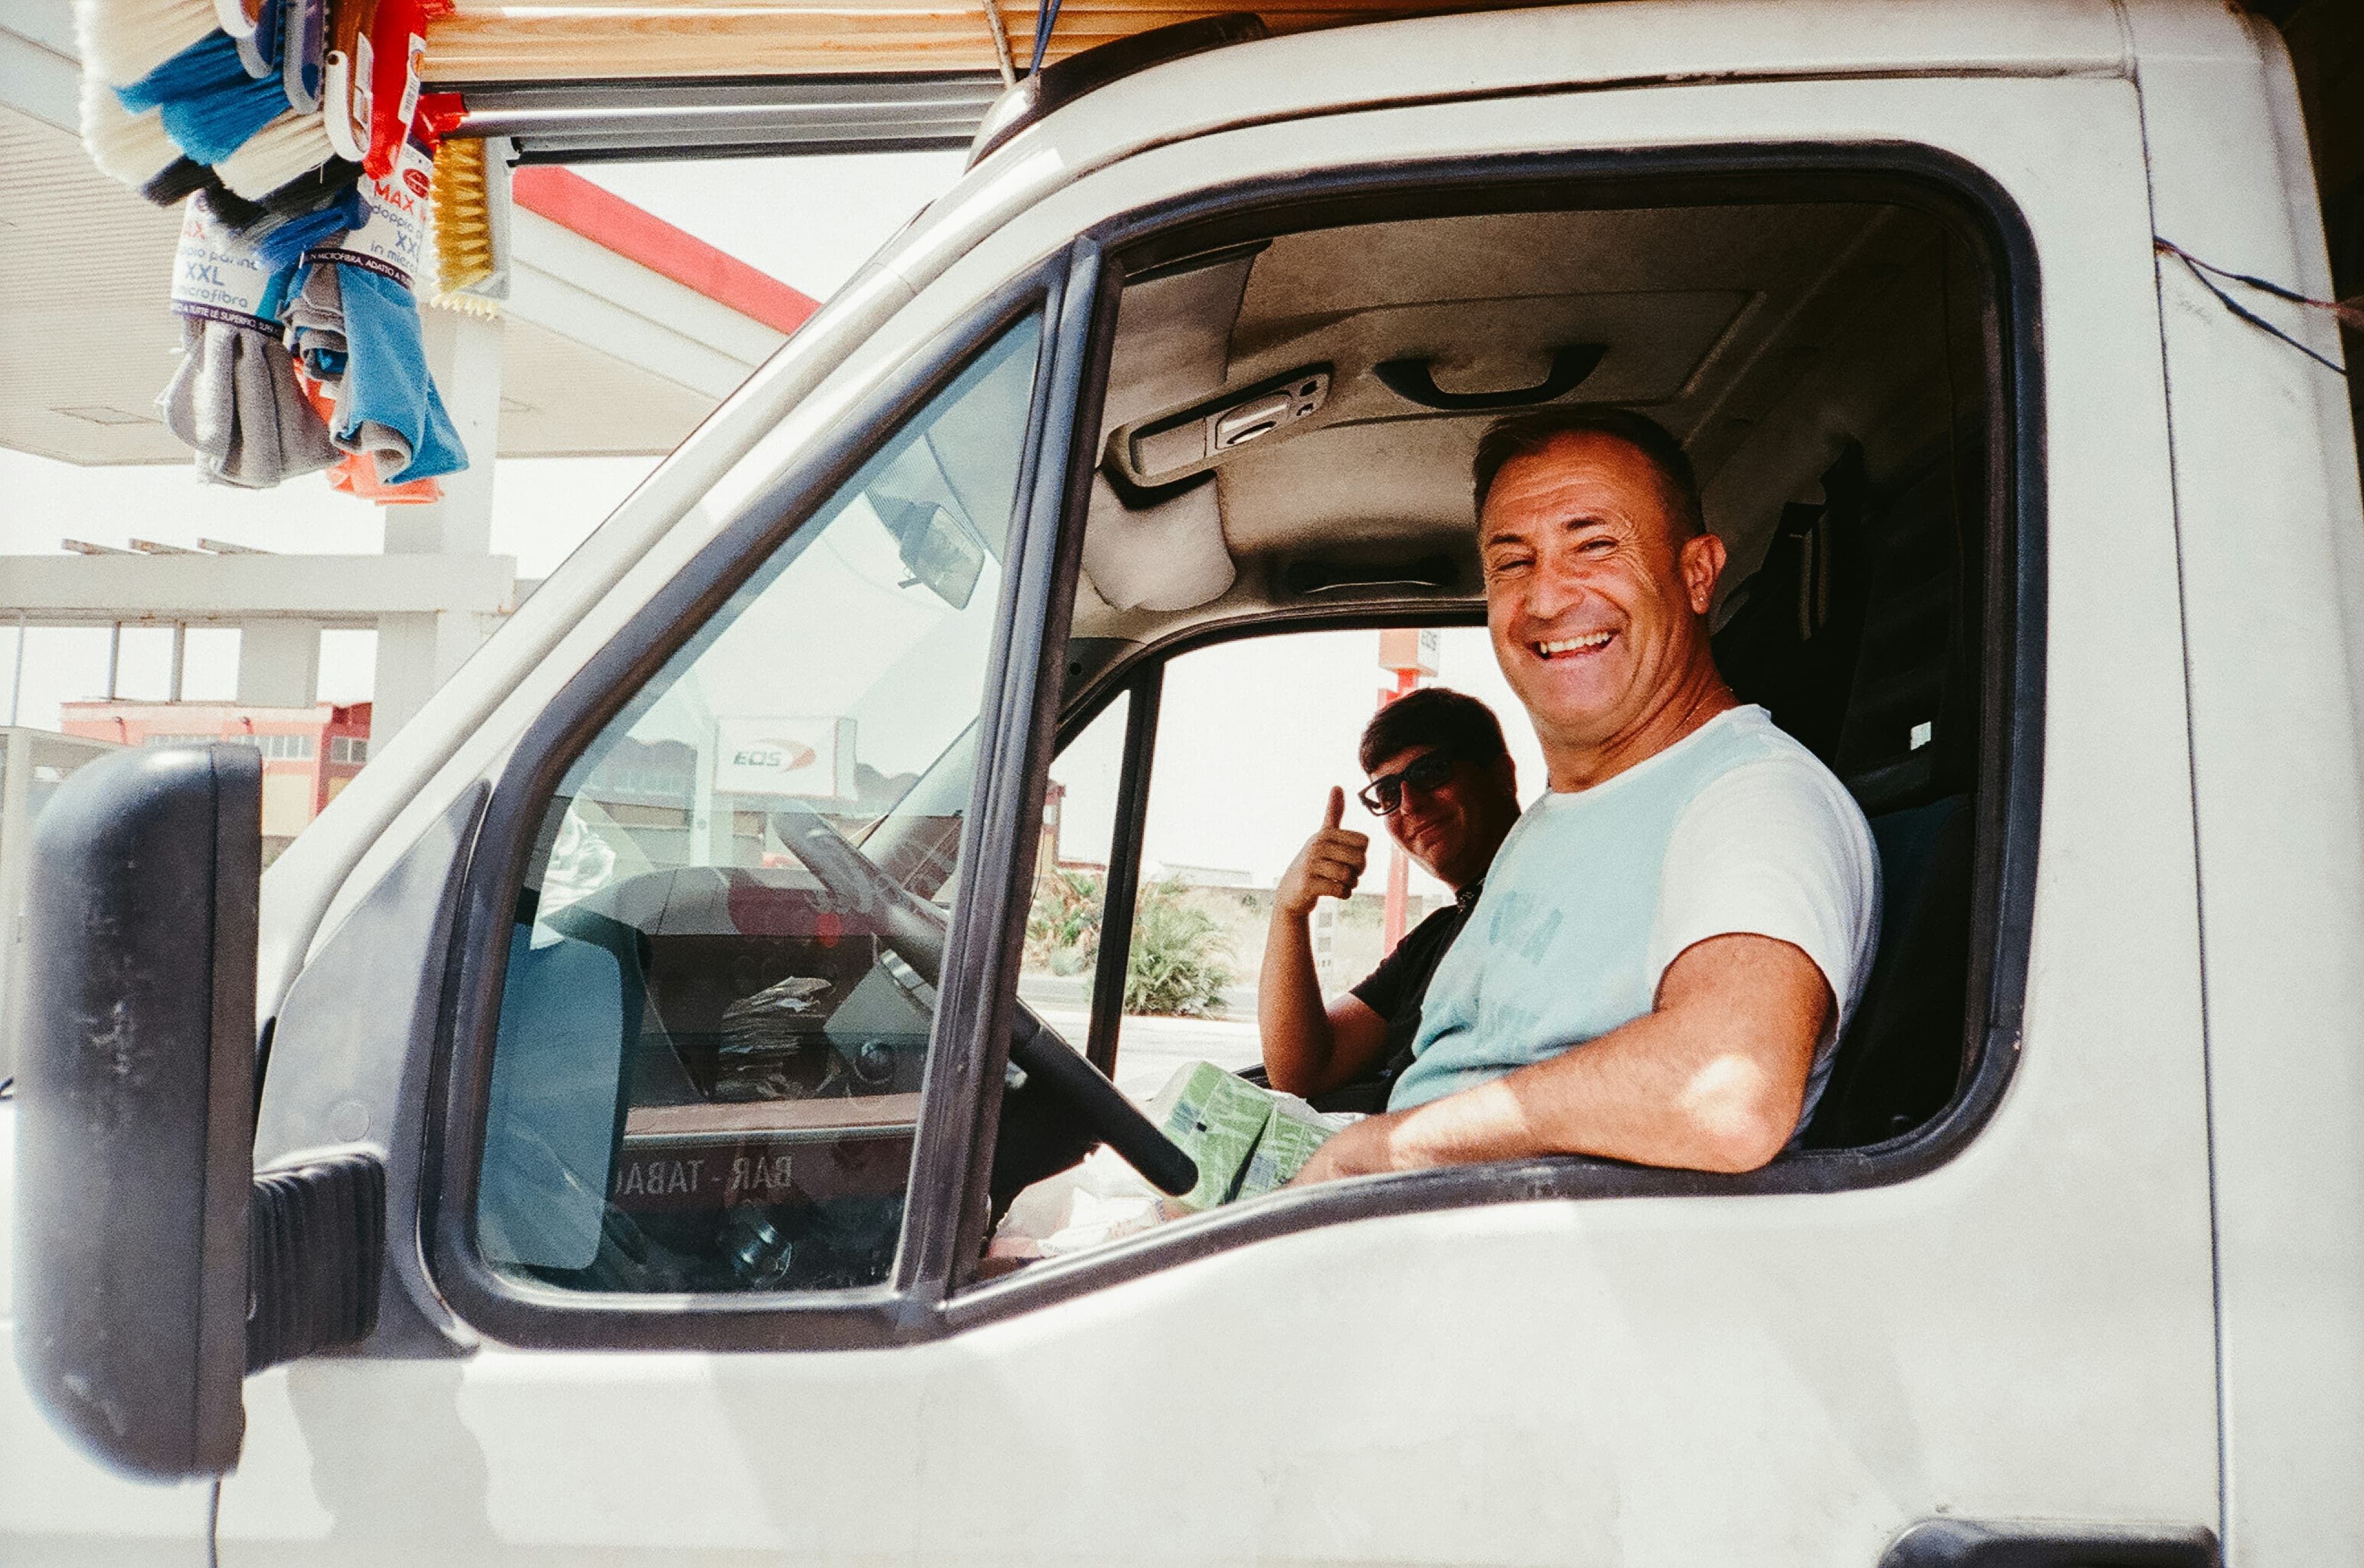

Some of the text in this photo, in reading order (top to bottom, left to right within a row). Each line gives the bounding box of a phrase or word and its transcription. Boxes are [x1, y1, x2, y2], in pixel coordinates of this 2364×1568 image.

[374, 180, 414, 215] MAX
[371, 203, 414, 232] doppio
[370, 241, 384, 255] in
[395, 230, 417, 257] XX
[187, 262, 225, 286] XXL
[733, 751, 781, 766] EOS
